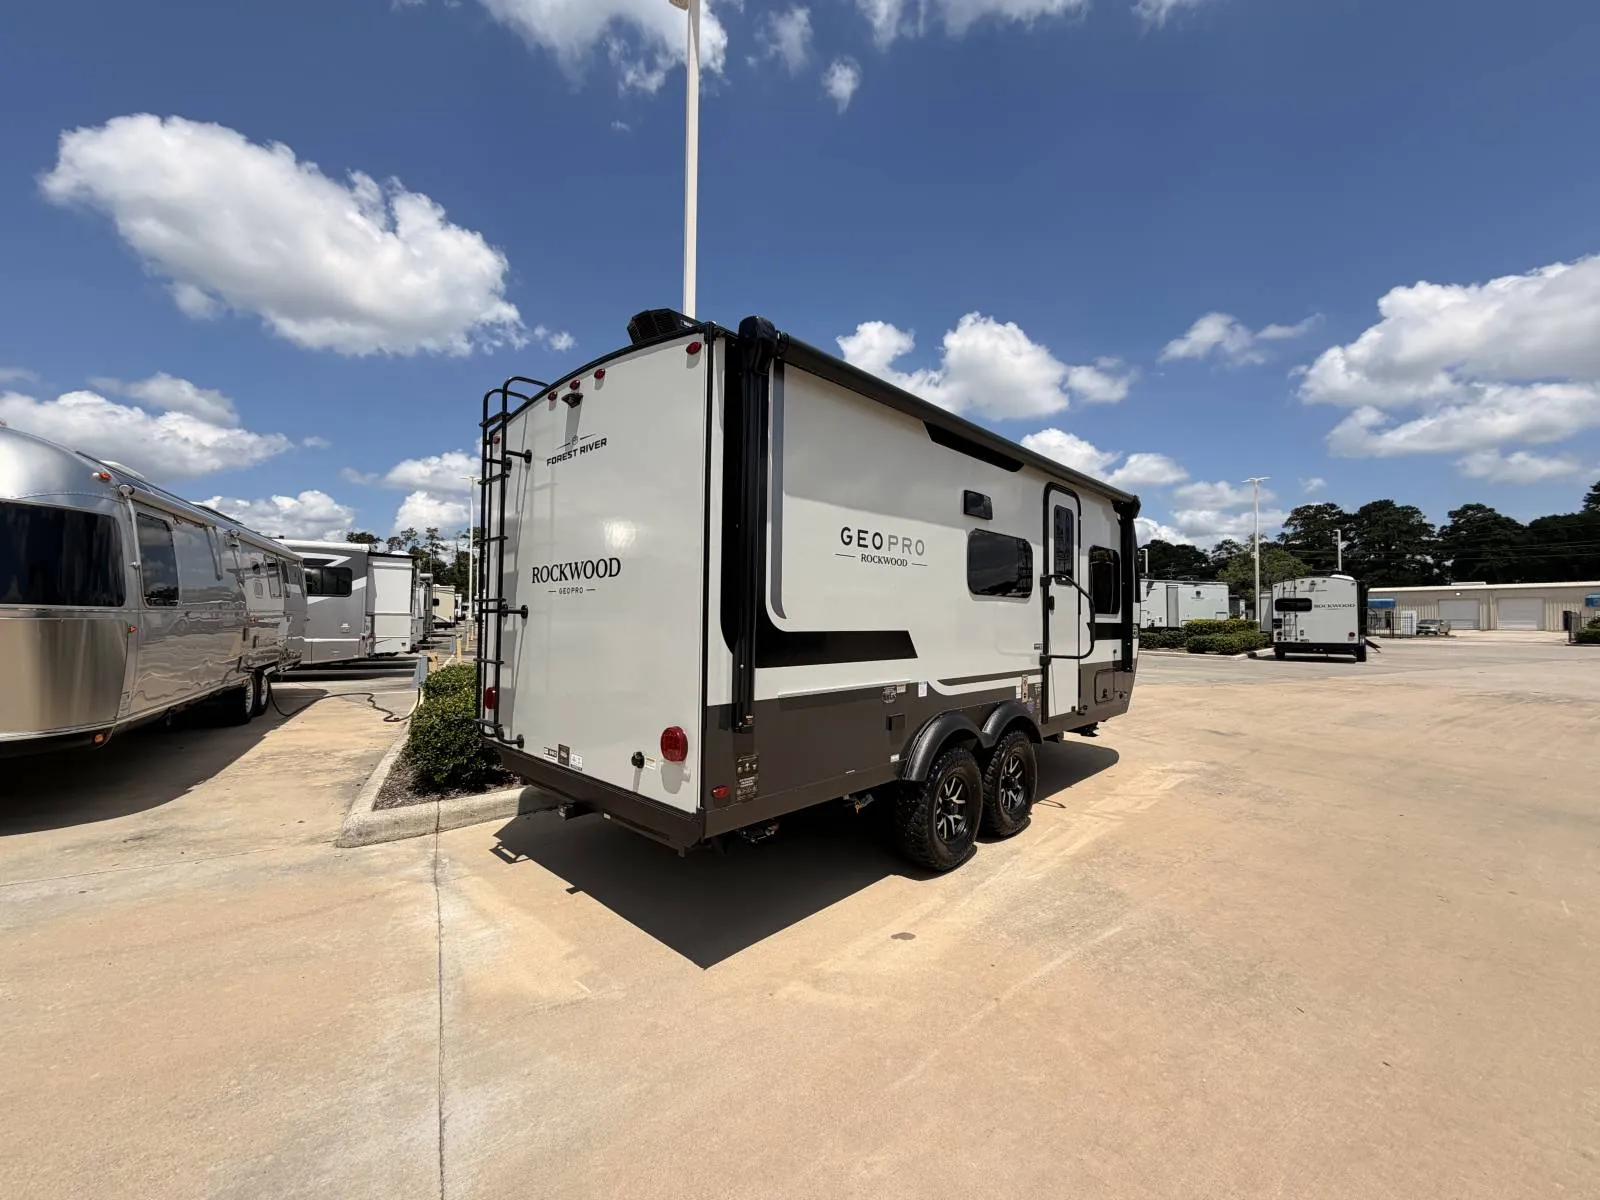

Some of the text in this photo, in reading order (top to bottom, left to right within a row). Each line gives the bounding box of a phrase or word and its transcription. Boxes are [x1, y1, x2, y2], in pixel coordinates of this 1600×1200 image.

[546, 437, 607, 467] FOREST RIVER
[840, 526, 925, 556] GEOPRO
[532, 557, 621, 584] ROCKWOOD
[861, 553, 908, 567] ROCKWOOD
[558, 586, 584, 595] GEOPRO
